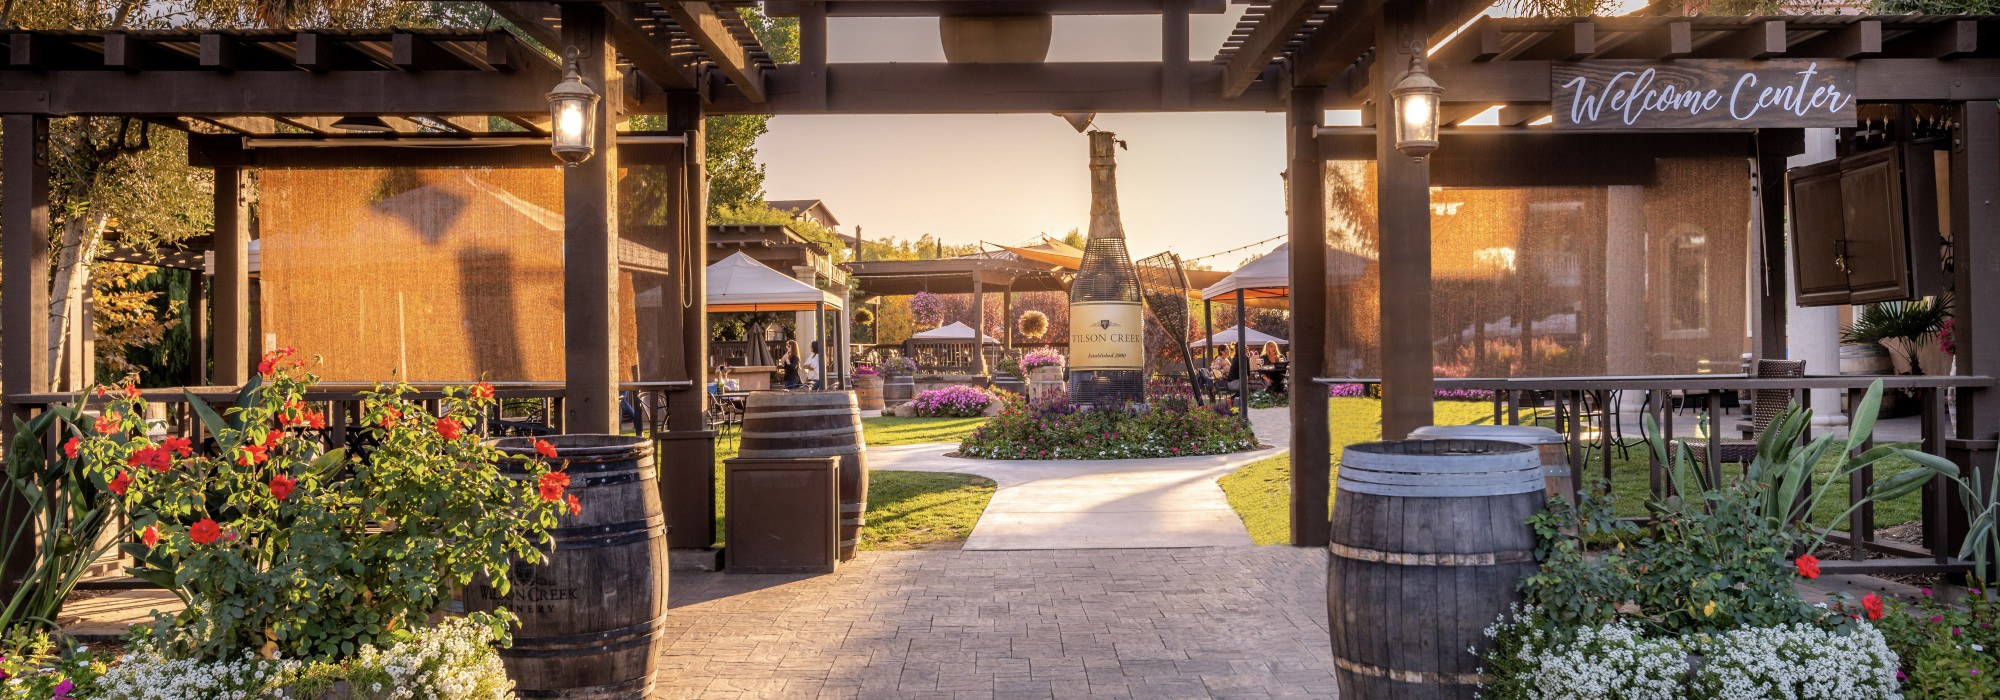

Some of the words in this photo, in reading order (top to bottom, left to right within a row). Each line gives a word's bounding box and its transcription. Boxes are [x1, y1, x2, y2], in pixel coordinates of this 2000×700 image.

[1562, 67, 1722, 125] Welcome
[1729, 62, 1851, 121] Center
[1110, 333, 1140, 343] CREEK
[479, 584, 525, 600] WILN
[528, 587, 577, 602] CREEK
